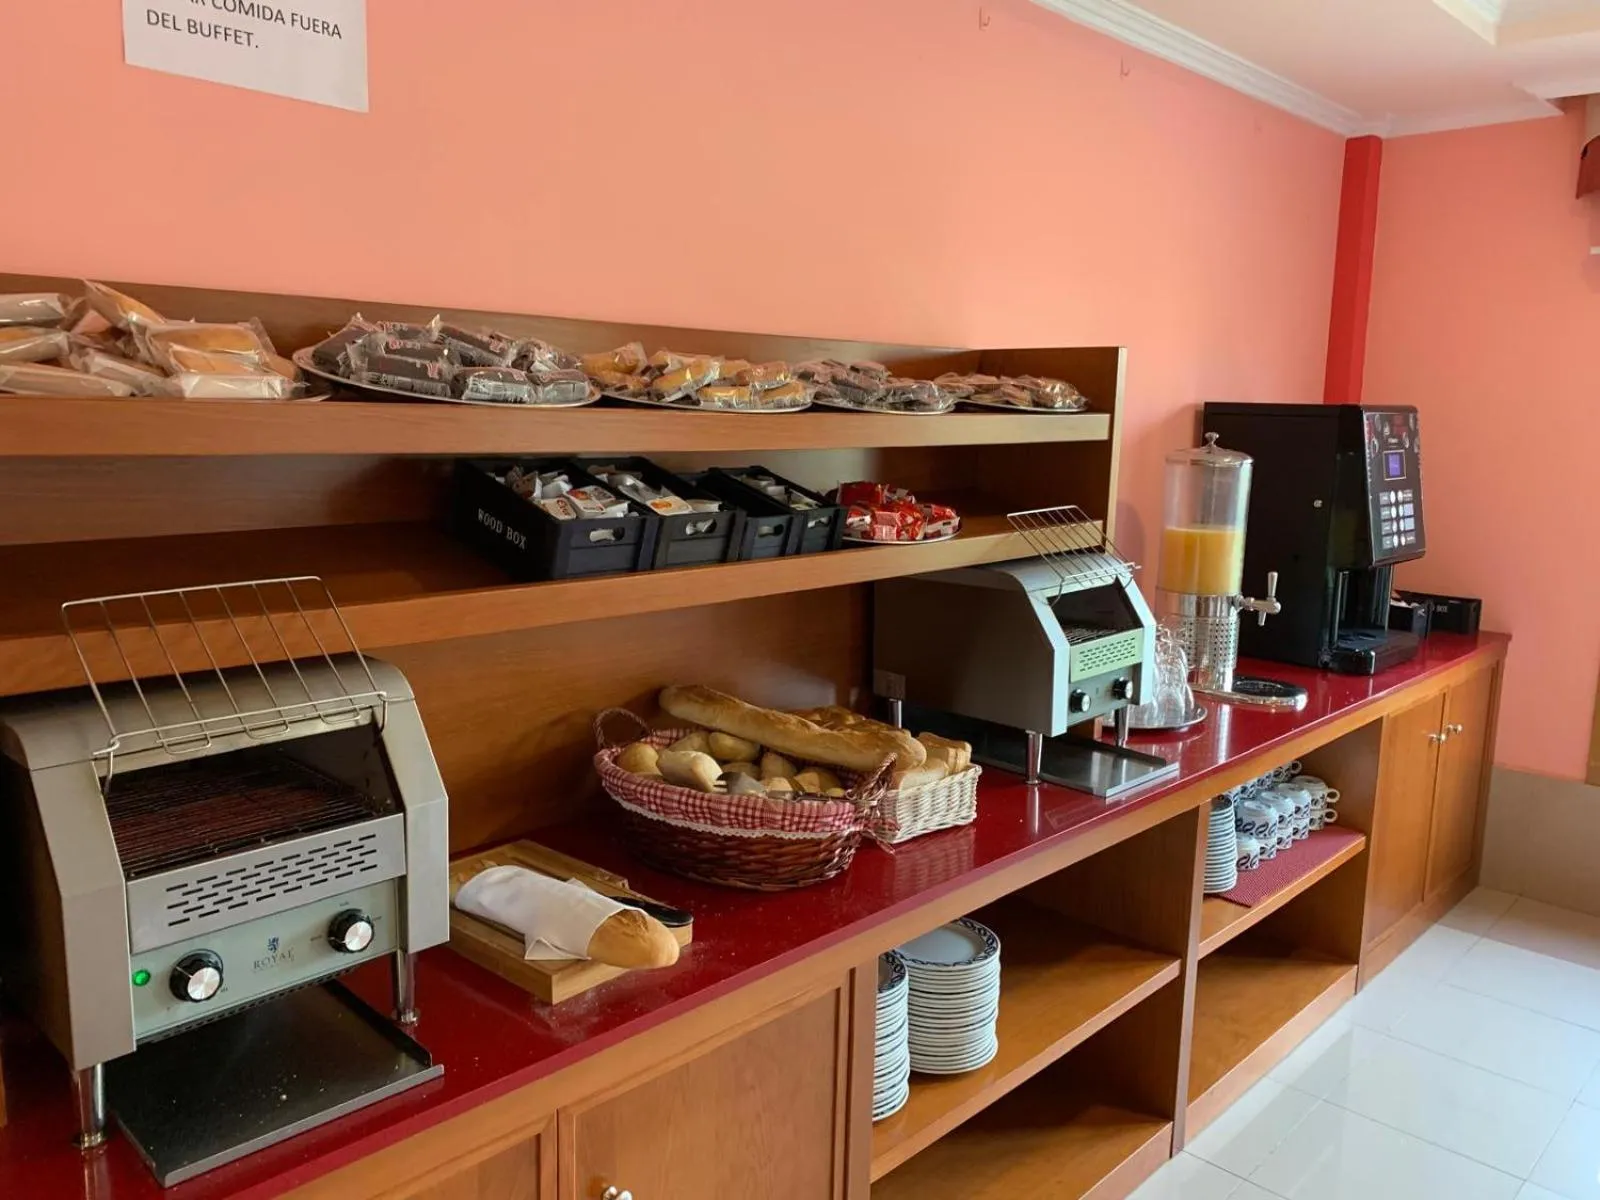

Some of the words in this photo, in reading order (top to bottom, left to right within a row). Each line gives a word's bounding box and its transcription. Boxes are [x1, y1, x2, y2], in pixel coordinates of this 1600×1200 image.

[146, 9, 182, 32] DEL
[187, 18, 259, 49] BUFFET.
[211, 0, 286, 25] COMIDA
[291, 12, 342, 40] FUERA
[478, 507, 503, 534] WOOD
[506, 526, 527, 550] BOX
